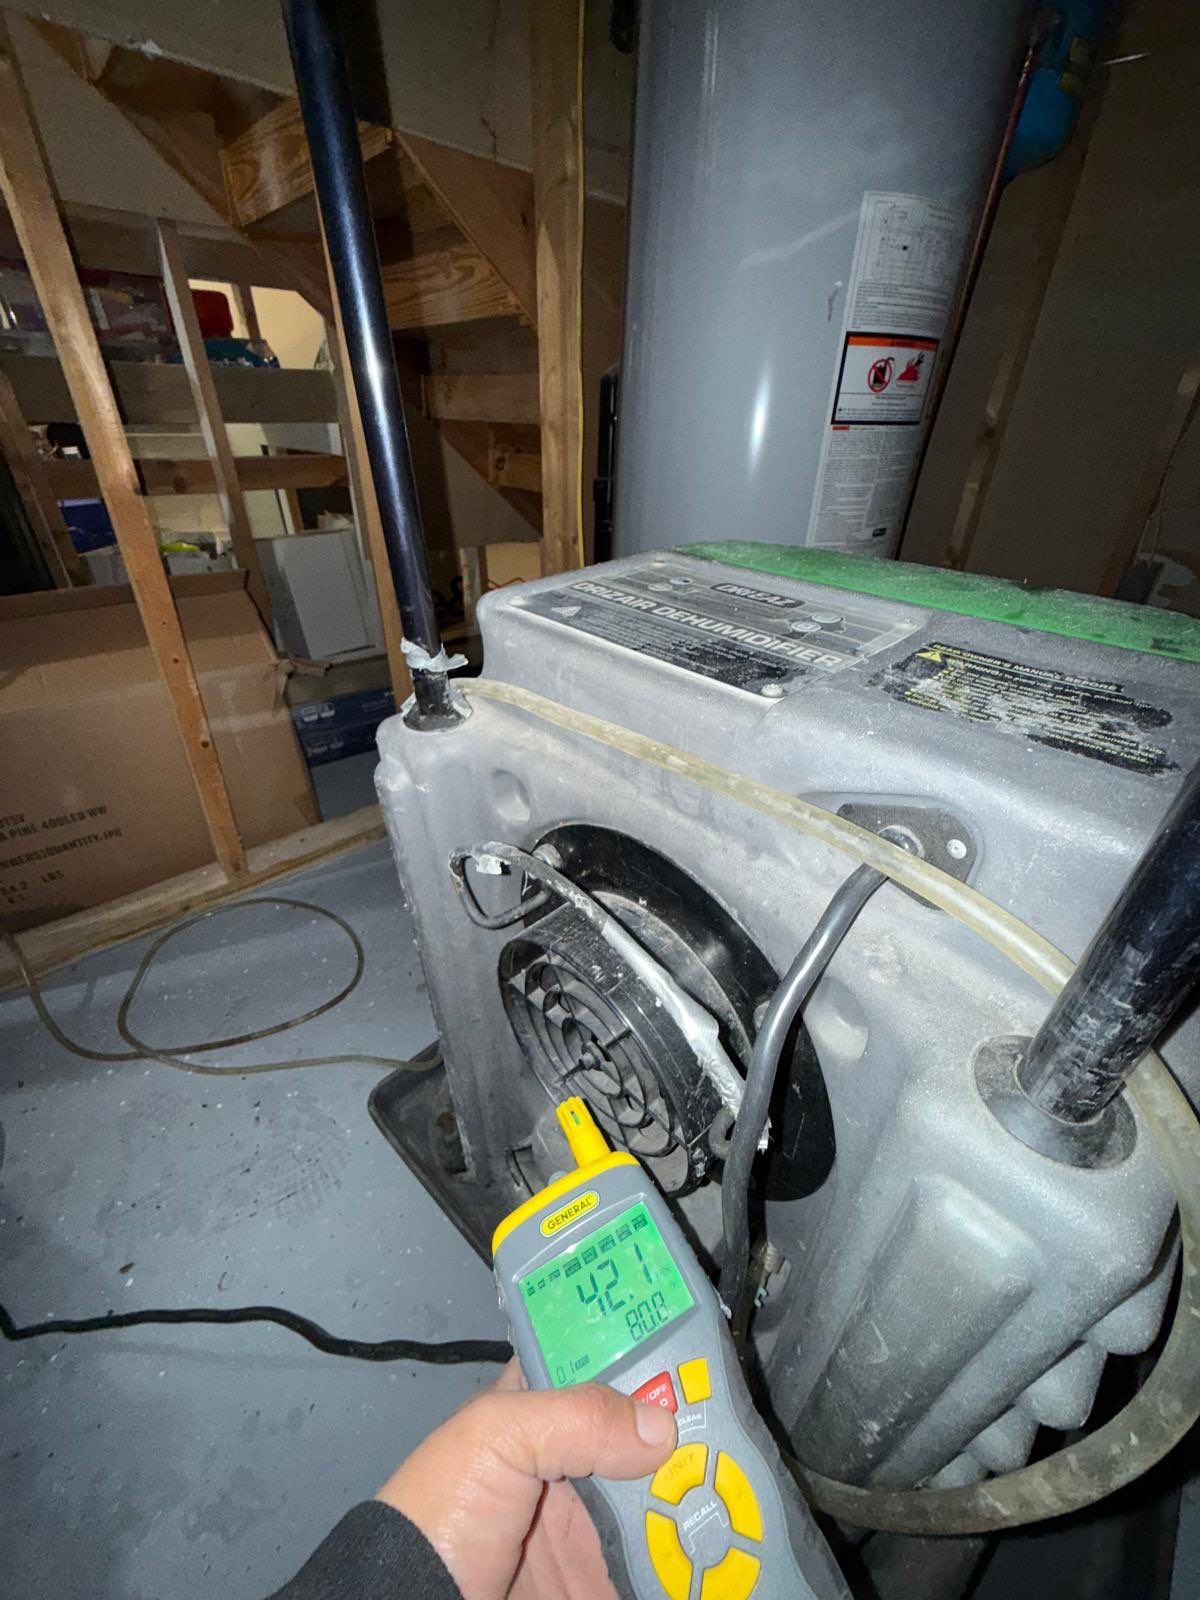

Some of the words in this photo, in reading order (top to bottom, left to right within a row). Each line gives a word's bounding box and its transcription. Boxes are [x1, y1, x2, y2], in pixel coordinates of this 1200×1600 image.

[574, 581, 651, 611] DRIZAIR
[652, 606, 843, 667] DEHUMIDIFIER
[547, 1198, 592, 1230] GENERAL
[576, 1242, 653, 1316] 42.1
[682, 1500, 718, 1531] RECALL
